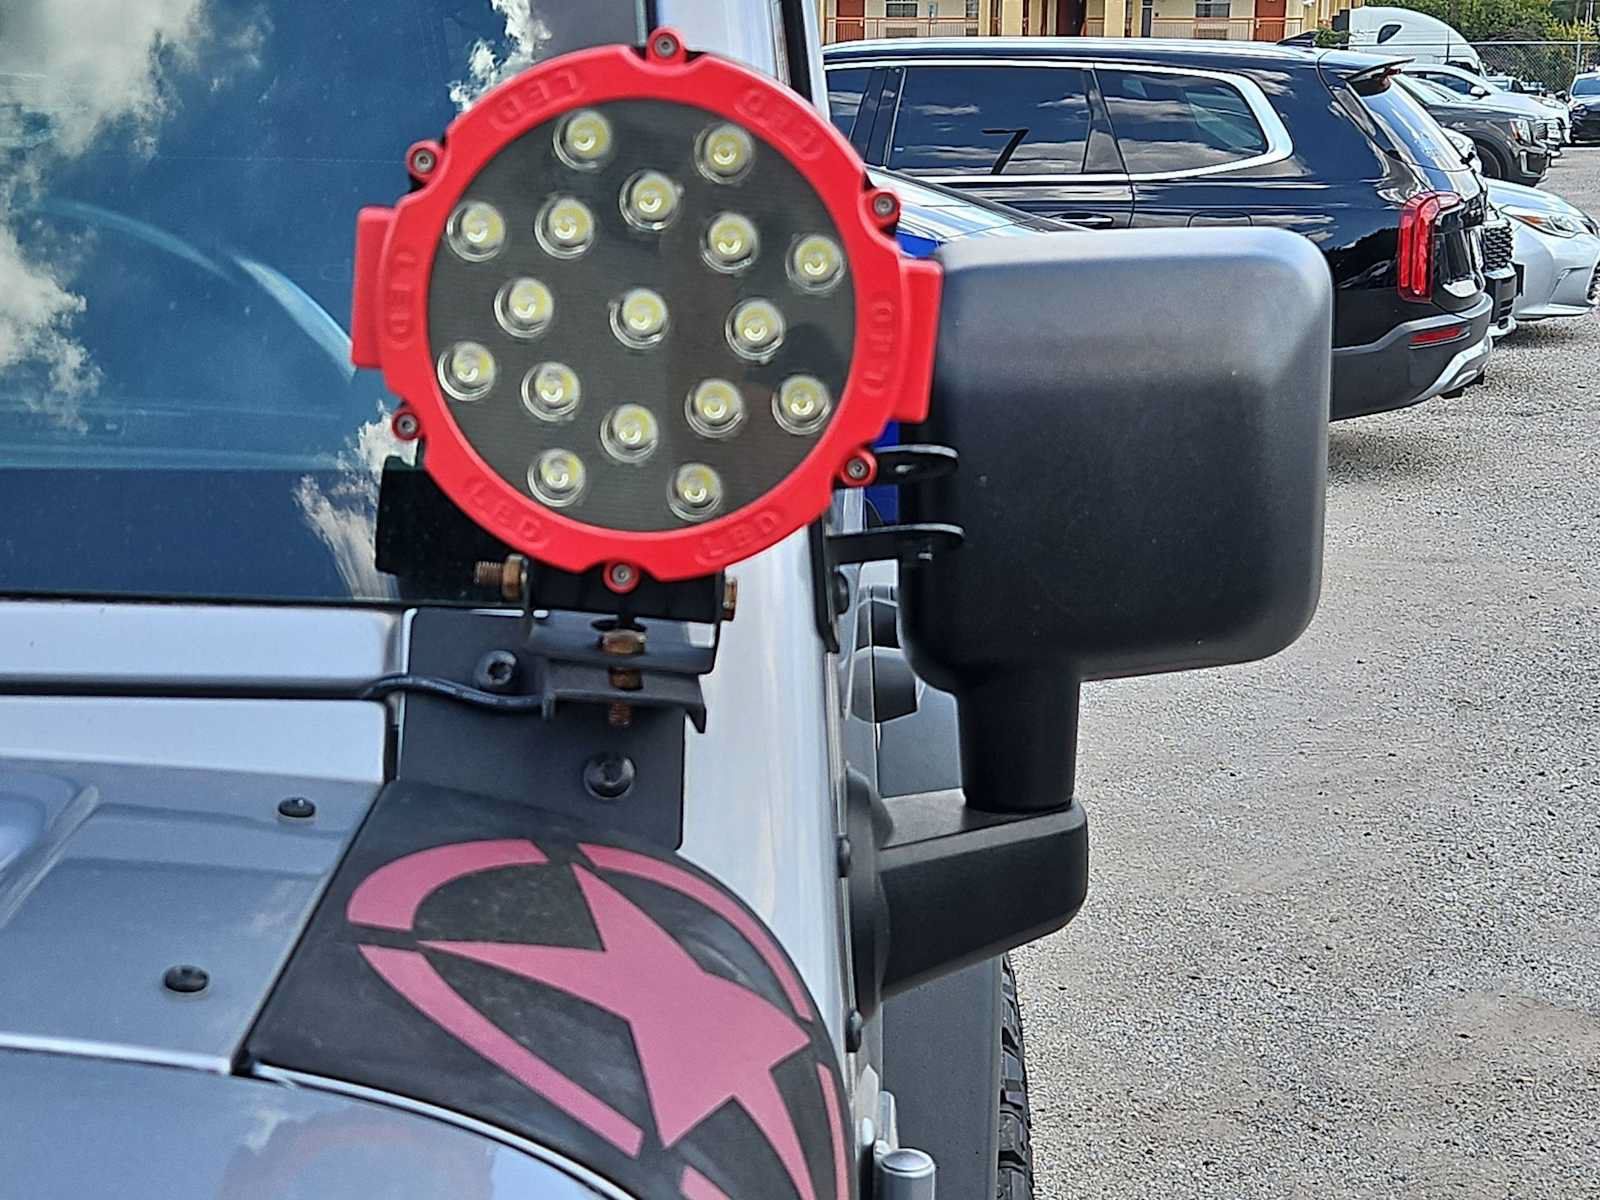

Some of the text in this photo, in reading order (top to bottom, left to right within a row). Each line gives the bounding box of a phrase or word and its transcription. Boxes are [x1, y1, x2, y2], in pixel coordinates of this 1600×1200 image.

[496, 69, 578, 122] LED
[742, 88, 818, 149] LED
[388, 251, 417, 338] LED
[863, 299, 895, 383] LED
[470, 480, 544, 538] LED
[702, 510, 778, 557] LED
